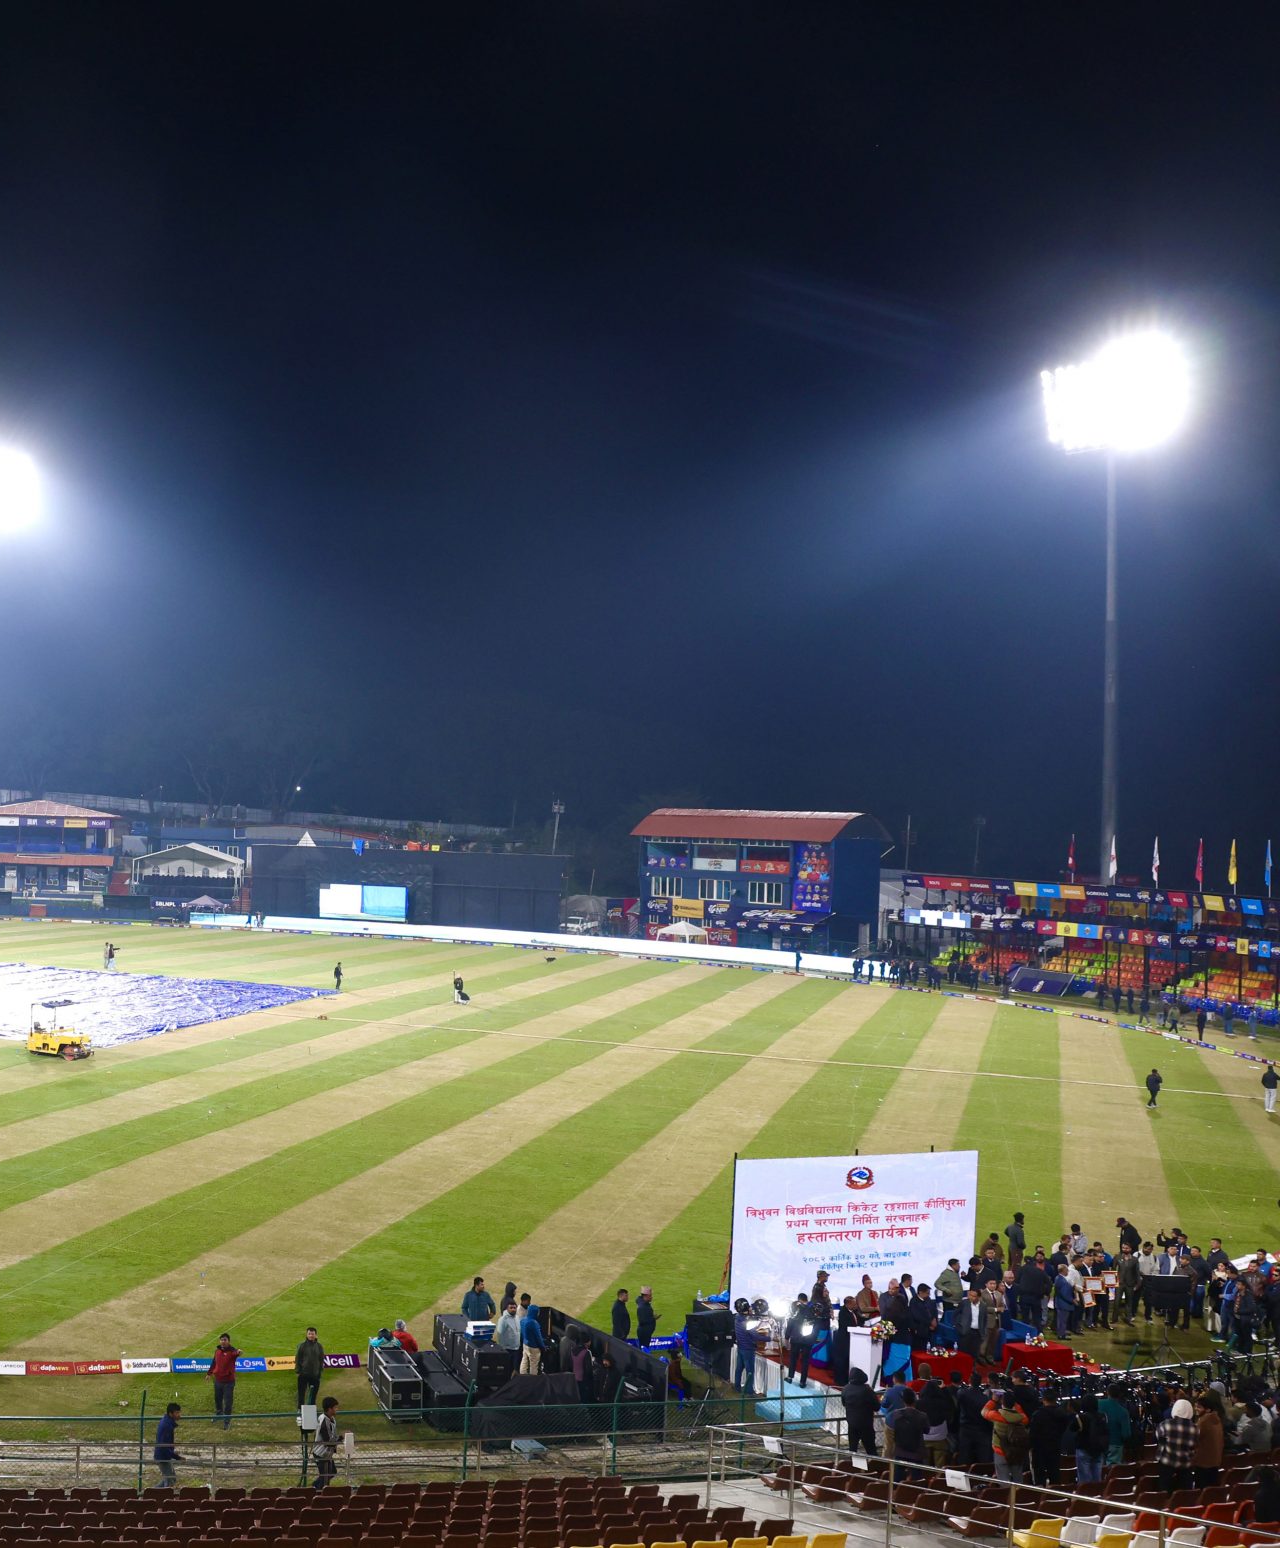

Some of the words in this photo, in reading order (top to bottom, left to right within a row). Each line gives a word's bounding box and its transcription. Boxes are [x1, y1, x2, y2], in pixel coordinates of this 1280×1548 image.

[847, 1201, 879, 1213] क्रिकेट
[924, 1197, 967, 1210] कीर्तिपुरमा
[786, 1219, 809, 1229] प्रथम
[814, 1217, 847, 1227] चरणमा
[852, 1213, 879, 1225] निर्मित
[796, 1230, 863, 1244] हस्तान्तरण
[867, 1224, 919, 1240] कार्यक्रम
[132, 1361, 153, 1369] Siddhartha
[154, 1361, 168, 1369] Capital
